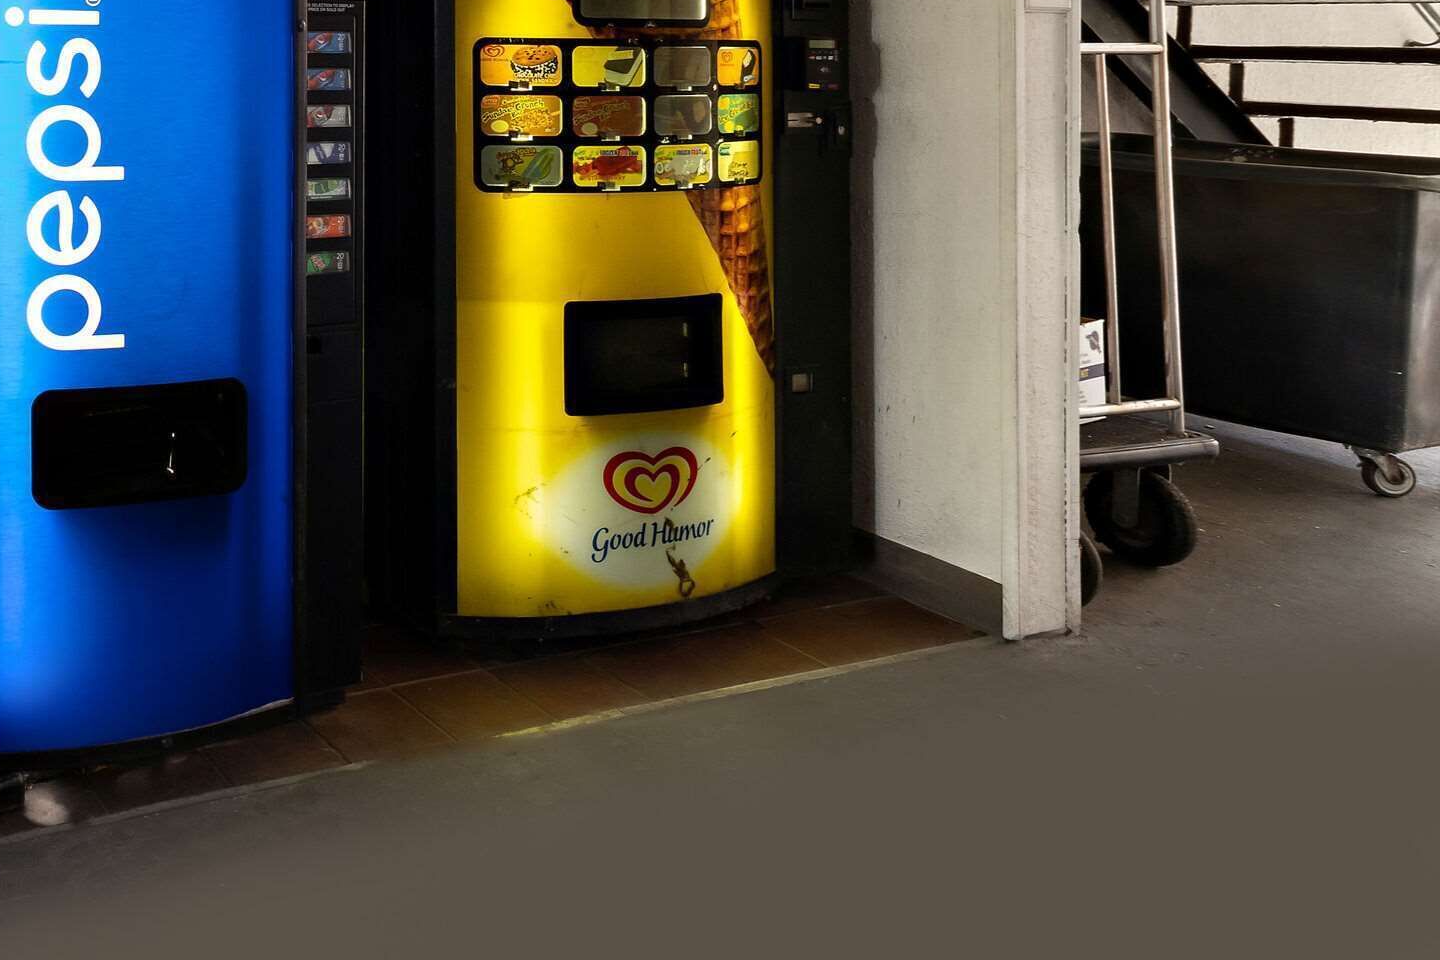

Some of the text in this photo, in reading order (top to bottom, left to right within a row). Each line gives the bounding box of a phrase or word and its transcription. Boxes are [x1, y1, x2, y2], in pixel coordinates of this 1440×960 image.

[4, 5, 125, 352] pepsi
[591, 518, 715, 563] Good Humor
